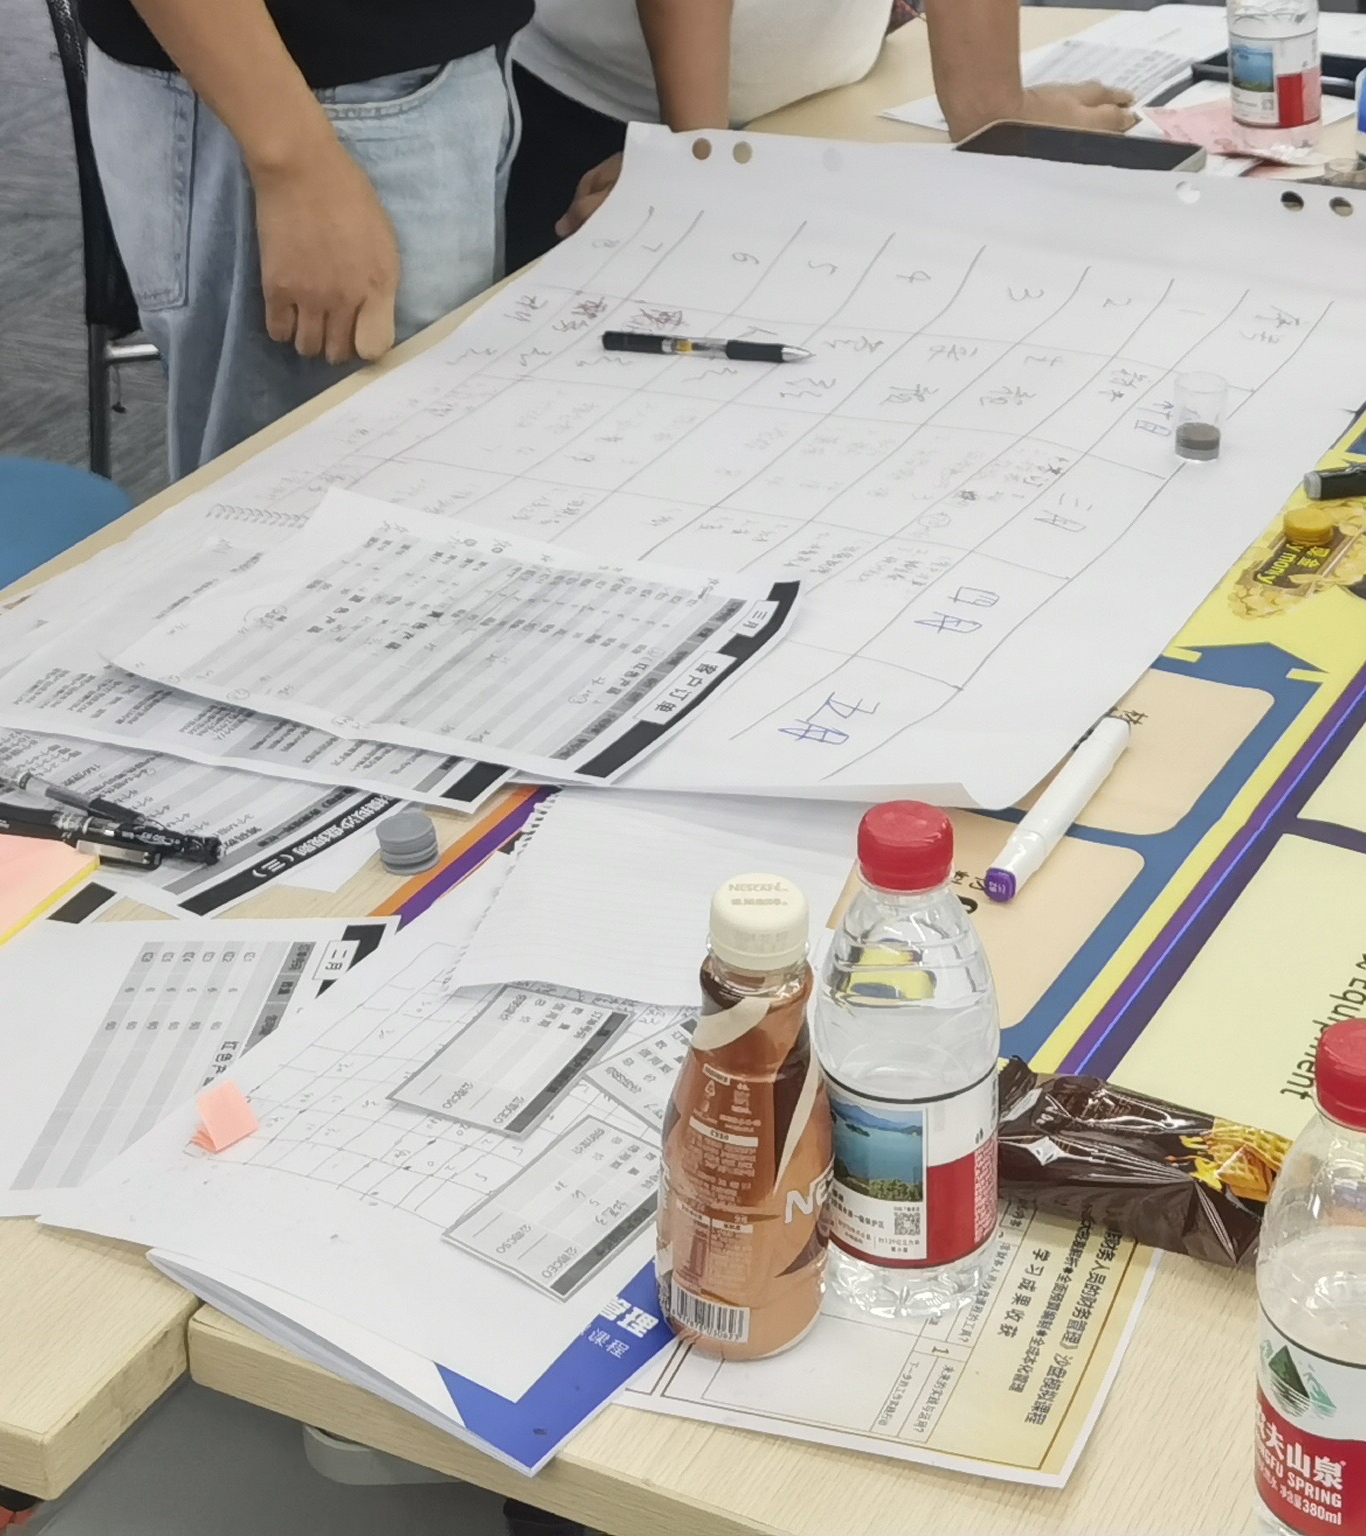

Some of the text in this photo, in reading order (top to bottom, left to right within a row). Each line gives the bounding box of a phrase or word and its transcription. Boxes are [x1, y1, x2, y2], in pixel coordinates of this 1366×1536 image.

[731, 248, 760, 268] 6
[1005, 280, 1044, 308] 3
[1102, 291, 1132, 314] 2
[742, 609, 768, 631] 三月
[654, 660, 718, 716] 客户订单
[778, 692, 879, 746] 五月
[325, 949, 348, 971] 二月
[996, 1245, 1050, 1341] 学习成果收获
[1288, 1472, 1342, 1508] SPRING
